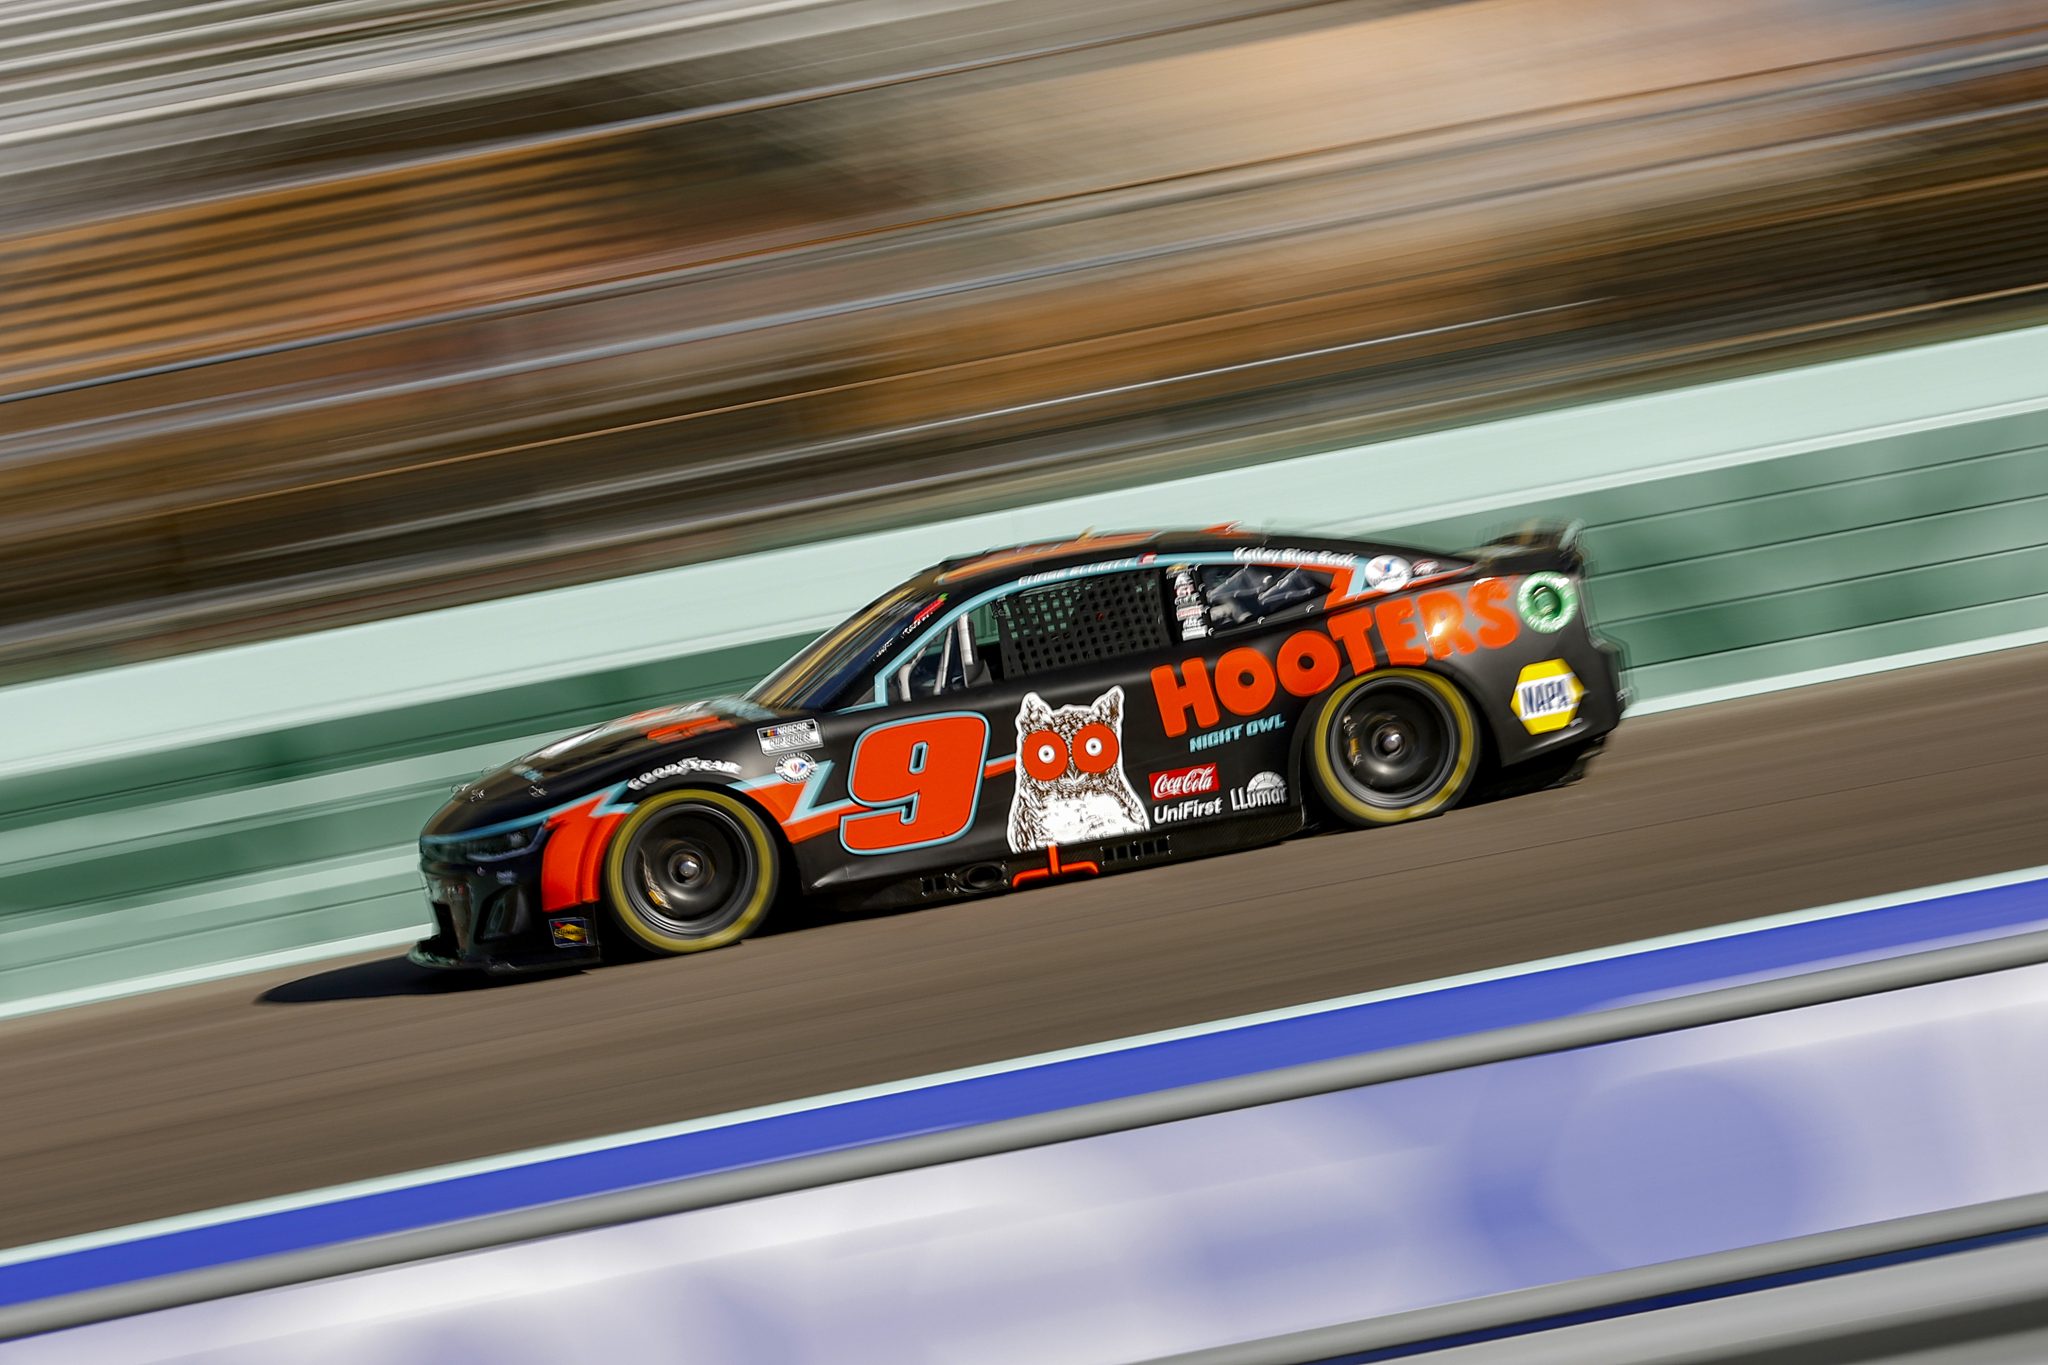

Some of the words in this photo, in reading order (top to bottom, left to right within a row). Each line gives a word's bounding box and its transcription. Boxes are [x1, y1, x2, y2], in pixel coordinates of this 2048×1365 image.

[1150, 577, 1521, 738] HOOTERS
[1521, 680, 1570, 716] NAPA
[1189, 724, 1243, 753] NIGHT
[1246, 713, 1287, 737] OWL
[840, 711, 991, 856] 9
[1230, 786, 1287, 811] LLumar
[1154, 797, 1223, 824] UniFirst
